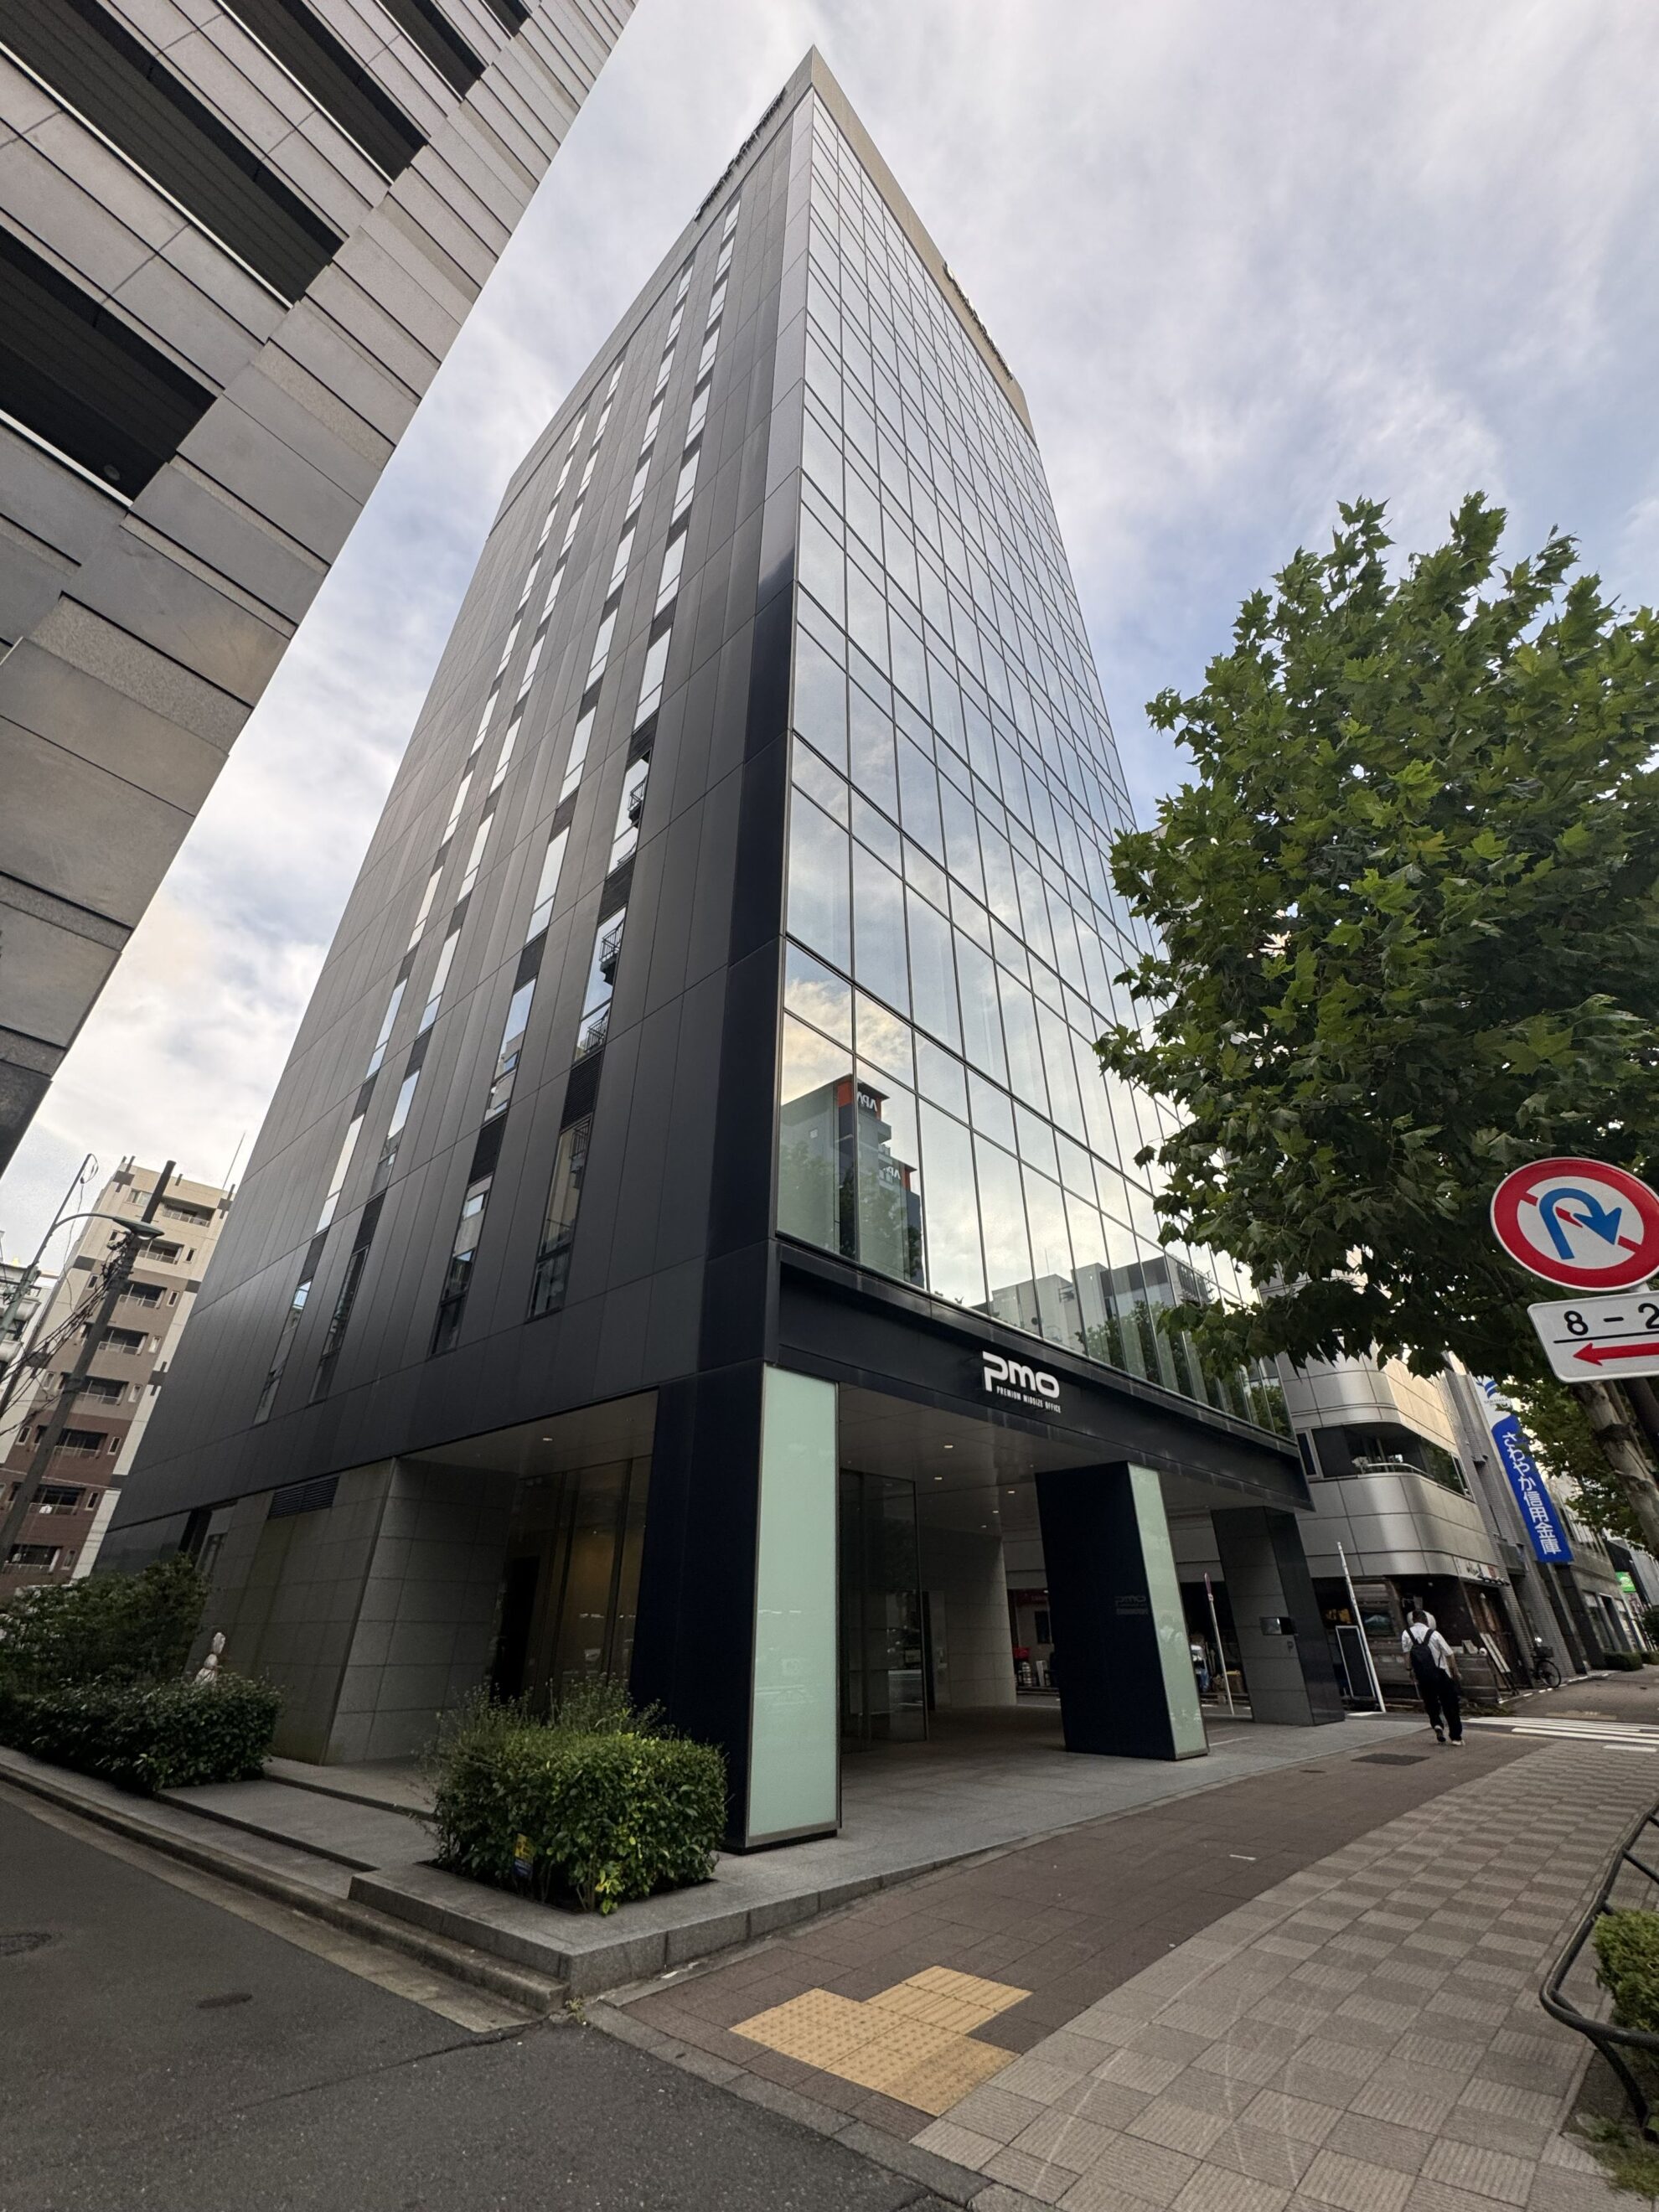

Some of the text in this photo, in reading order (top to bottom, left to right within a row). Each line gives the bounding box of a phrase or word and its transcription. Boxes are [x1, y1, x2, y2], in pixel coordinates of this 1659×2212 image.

[996, 1385, 1062, 1414] PREMIUM MIDSIZE OFFICE
[1501, 1431, 1562, 1555] さわやか信用金庫
